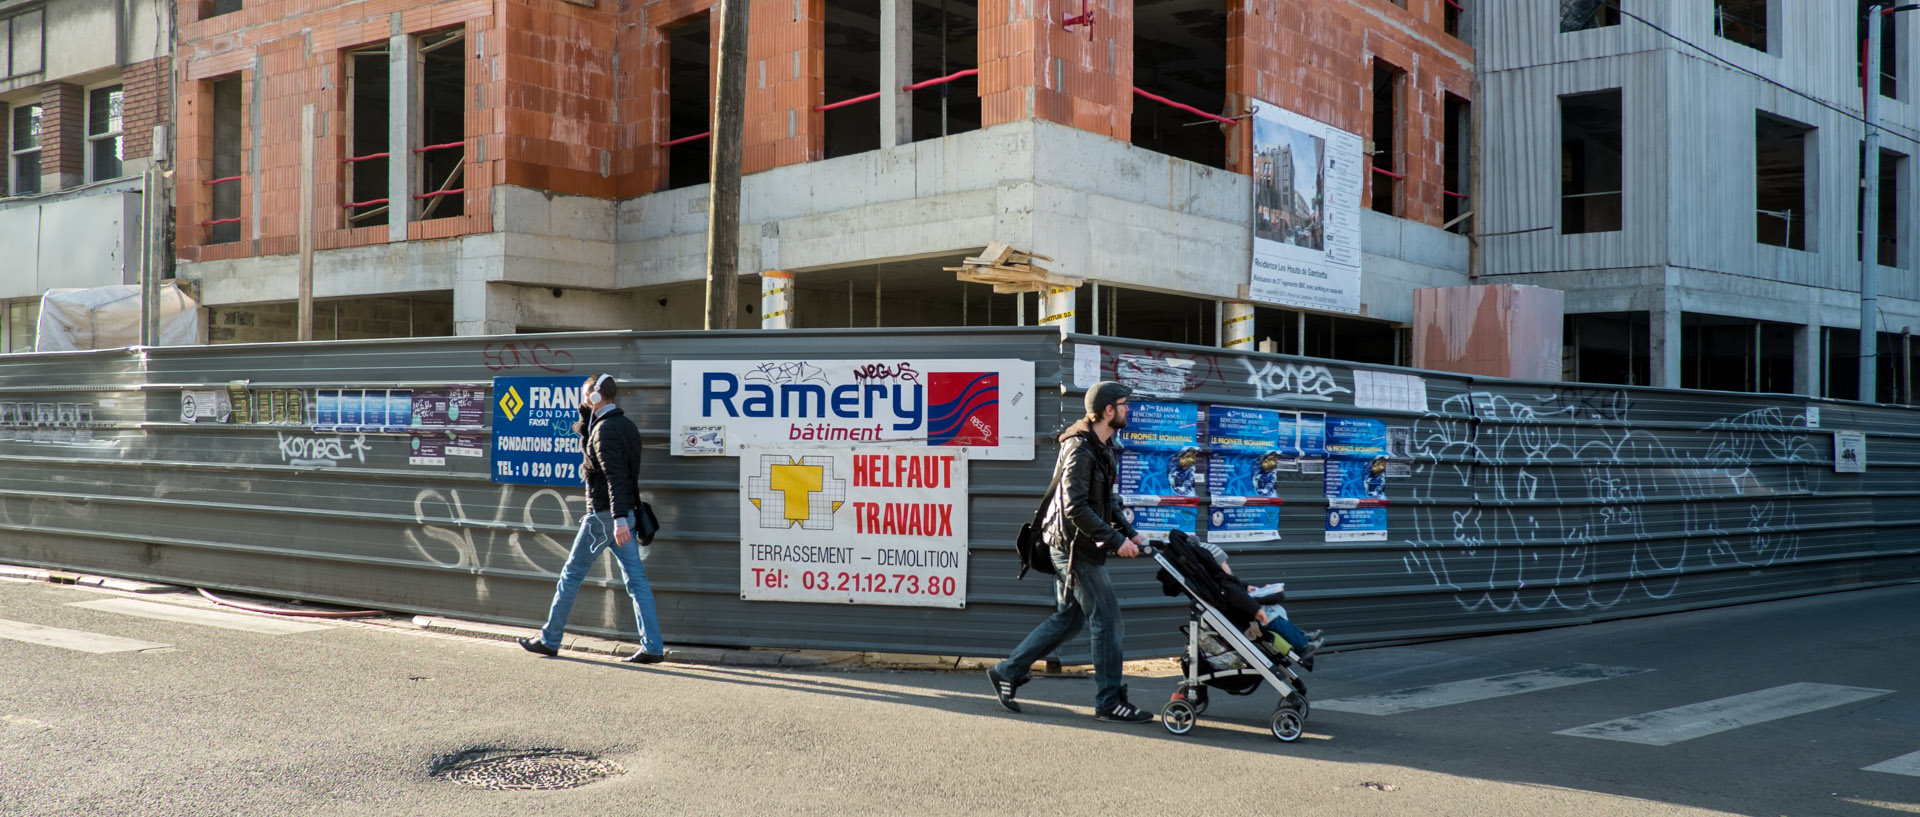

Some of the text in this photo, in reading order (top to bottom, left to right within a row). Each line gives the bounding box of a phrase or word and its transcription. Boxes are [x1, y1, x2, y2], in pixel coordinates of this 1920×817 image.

[702, 372, 923, 431] Ramery
[529, 418, 550, 426] FAYAT
[789, 423, 883, 441] bâtiment
[498, 436, 552, 452] FONDATIONS
[497, 461, 513, 476] TEL
[522, 462, 529, 477] 0
[532, 462, 552, 477] 820
[555, 463, 575, 479] 072
[853, 455, 954, 488] HELFAUT
[853, 502, 953, 537] TRAVAUX
[750, 544, 854, 564] TERRASSEMENT
[878, 549, 959, 569] DEMOLITION
[751, 568, 956, 596] Tél: 03.21.12.73.80
